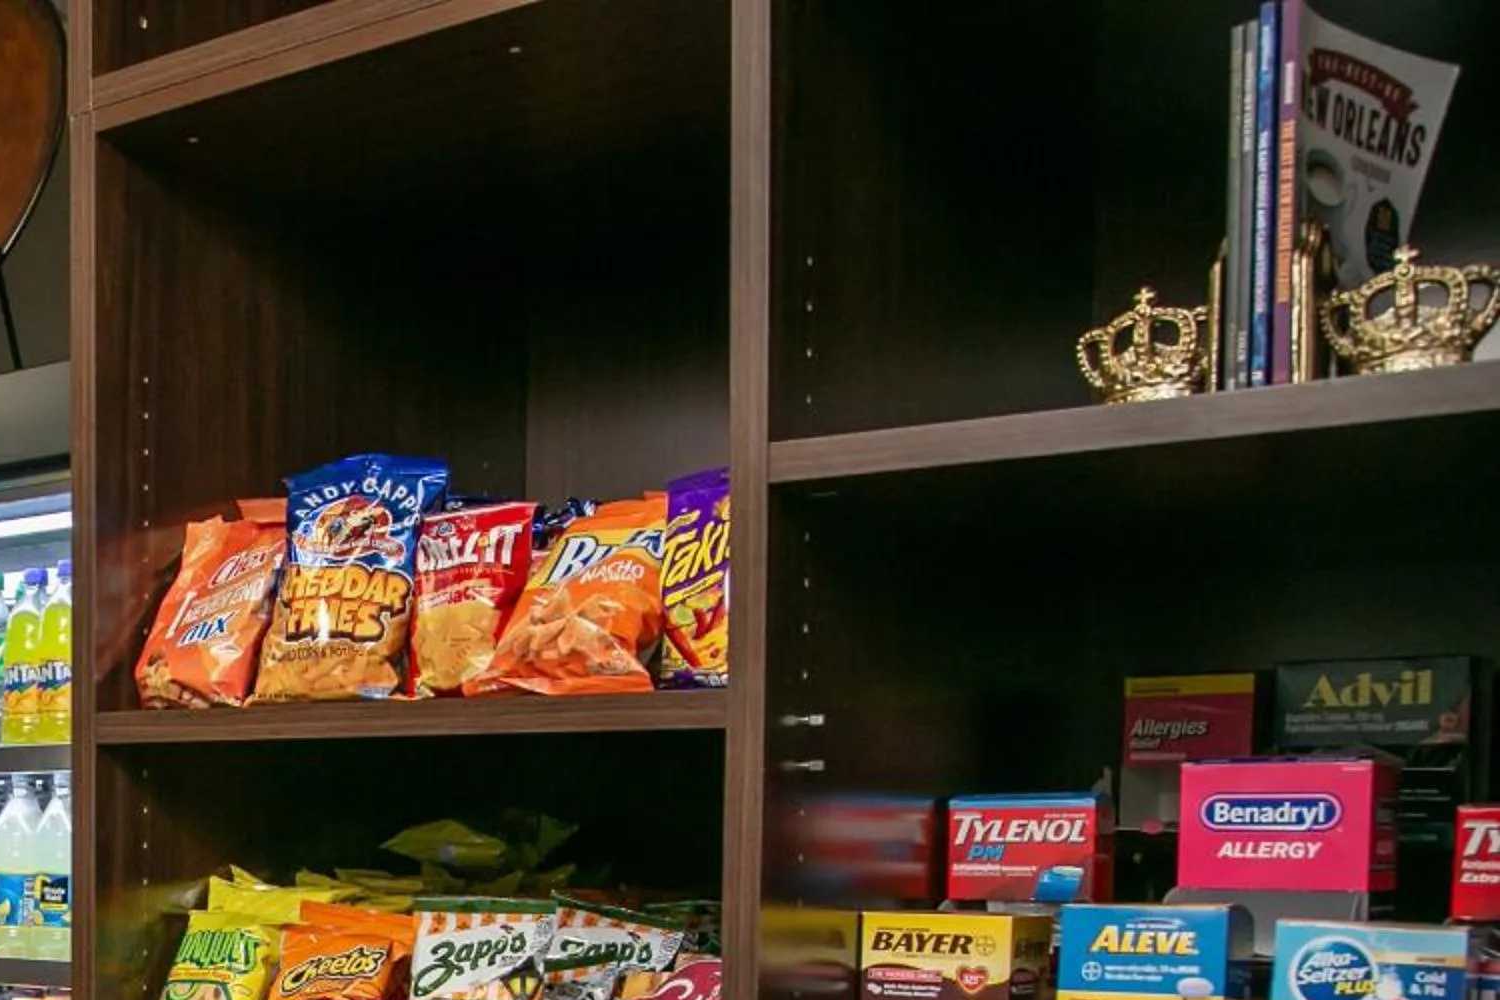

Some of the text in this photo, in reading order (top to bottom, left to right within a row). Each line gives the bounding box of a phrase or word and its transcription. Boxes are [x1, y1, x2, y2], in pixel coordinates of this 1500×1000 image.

[1332, 93, 1427, 168] ORLEANS
[296, 480, 355, 520] ANDY
[660, 521, 731, 588] Taki
[582, 560, 644, 584] NACHO
[284, 566, 410, 611] HEDDAR
[1303, 669, 1434, 708] Advil
[1130, 718, 1208, 738] Allergies
[953, 812, 1087, 846] TYLENOL
[1213, 801, 1327, 831] Benadryl
[1216, 840, 1323, 859] ALLERGY
[871, 931, 974, 955] BAYER
[1090, 924, 1199, 956] ALEVE
[283, 945, 386, 994] Cheetos
[1297, 967, 1371, 985] Seltzer
[1302, 951, 1359, 969] Alka-
